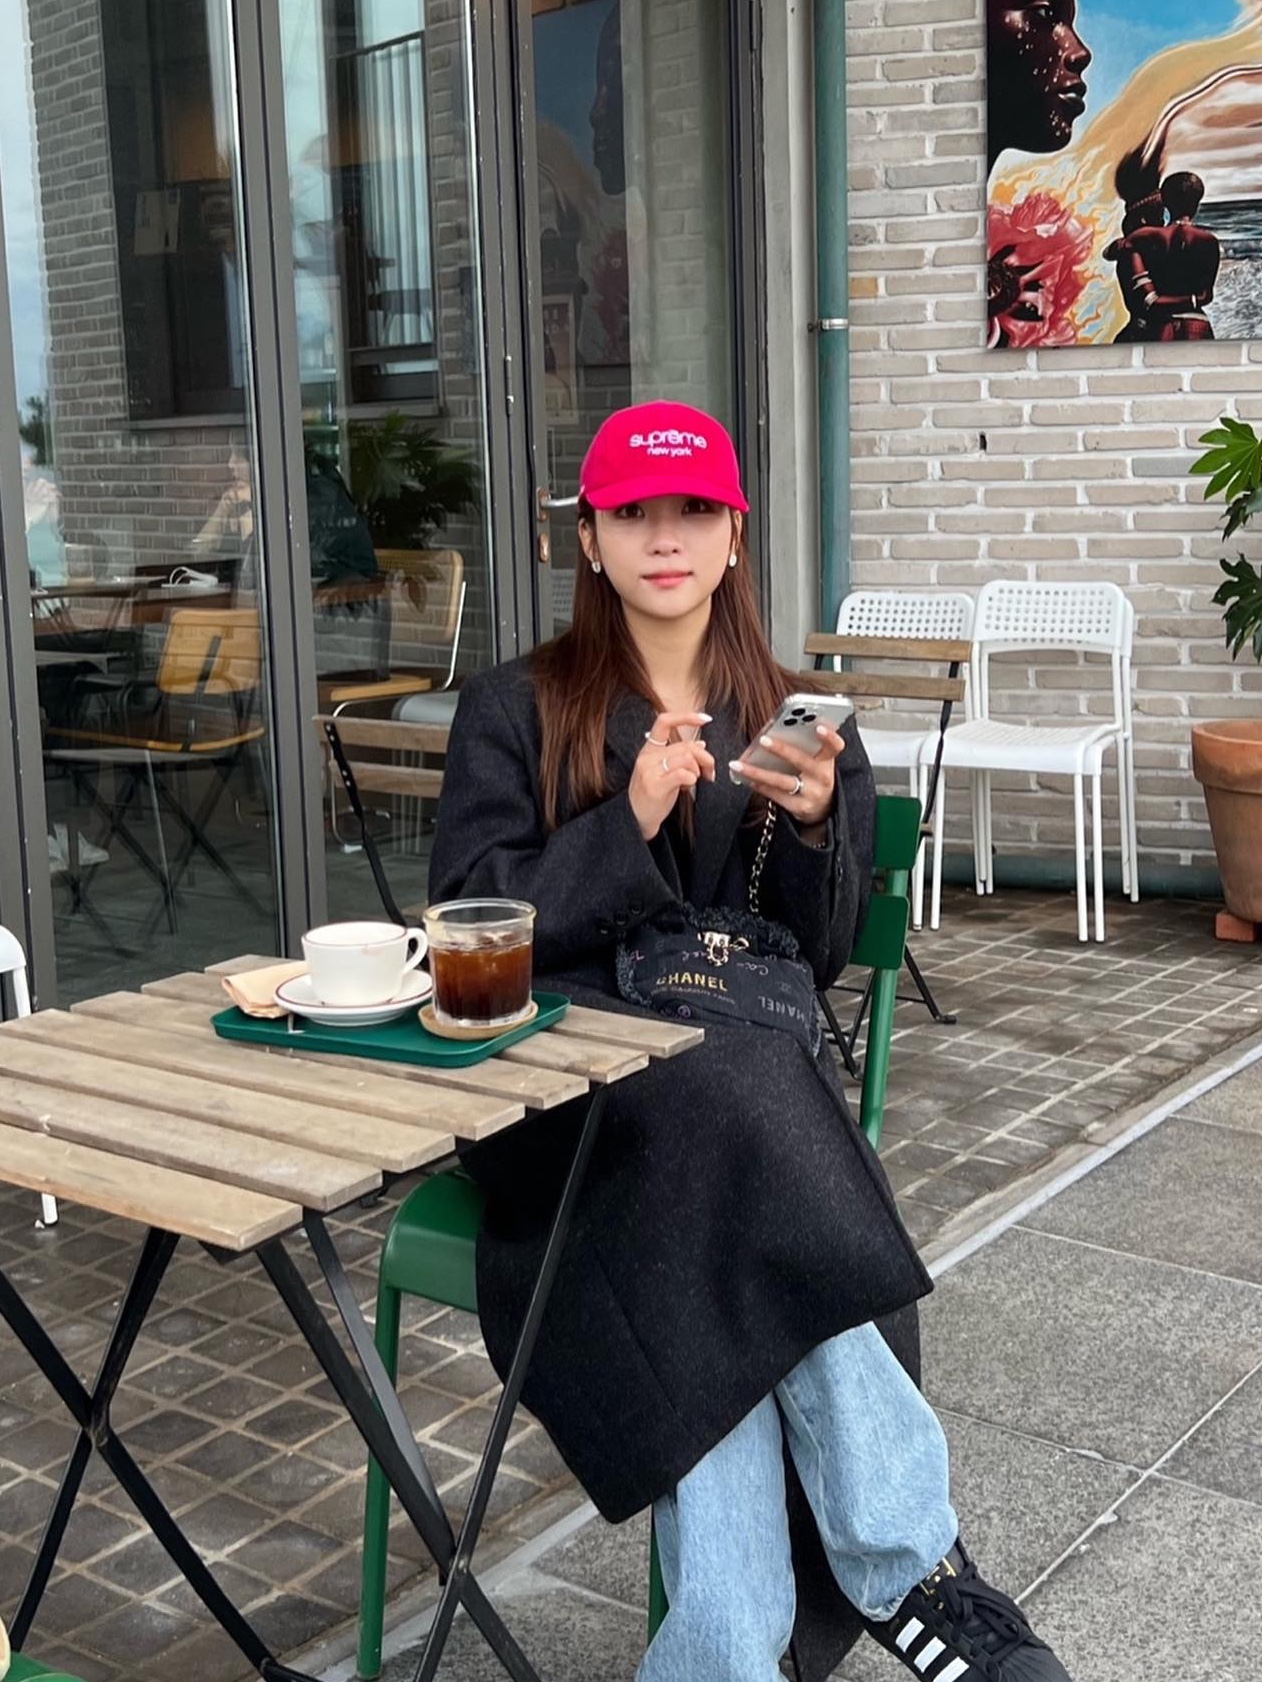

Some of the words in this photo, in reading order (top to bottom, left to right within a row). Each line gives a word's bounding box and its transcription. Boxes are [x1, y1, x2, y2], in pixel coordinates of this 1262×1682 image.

[630, 429, 707, 449] supreme
[648, 447, 669, 456] new
[670, 447, 692, 457] york
[758, 996, 805, 1022] HANEL
